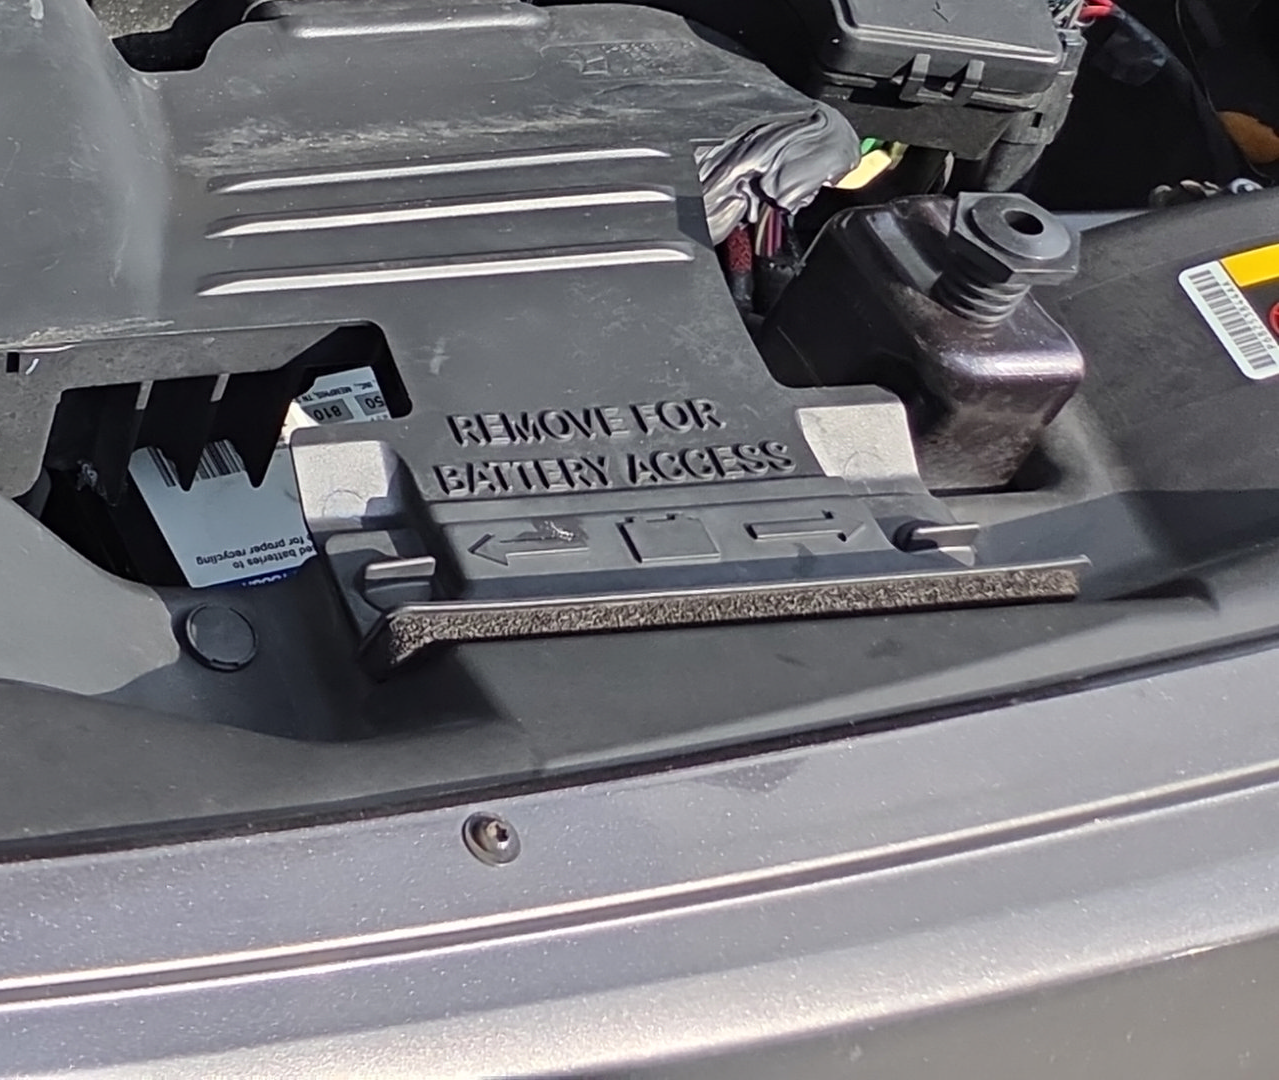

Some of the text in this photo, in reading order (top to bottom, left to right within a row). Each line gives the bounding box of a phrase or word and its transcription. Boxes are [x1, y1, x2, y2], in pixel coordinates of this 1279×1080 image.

[313, 405, 343, 421] 810
[446, 398, 727, 447] REMOVE FOR
[432, 439, 796, 497] BATTERY ACCESS
[250, 538, 286, 554] proper
[288, 536, 304, 546] for
[196, 548, 246, 566] recycling
[232, 560, 245, 569] to
[247, 548, 297, 566] batteries
